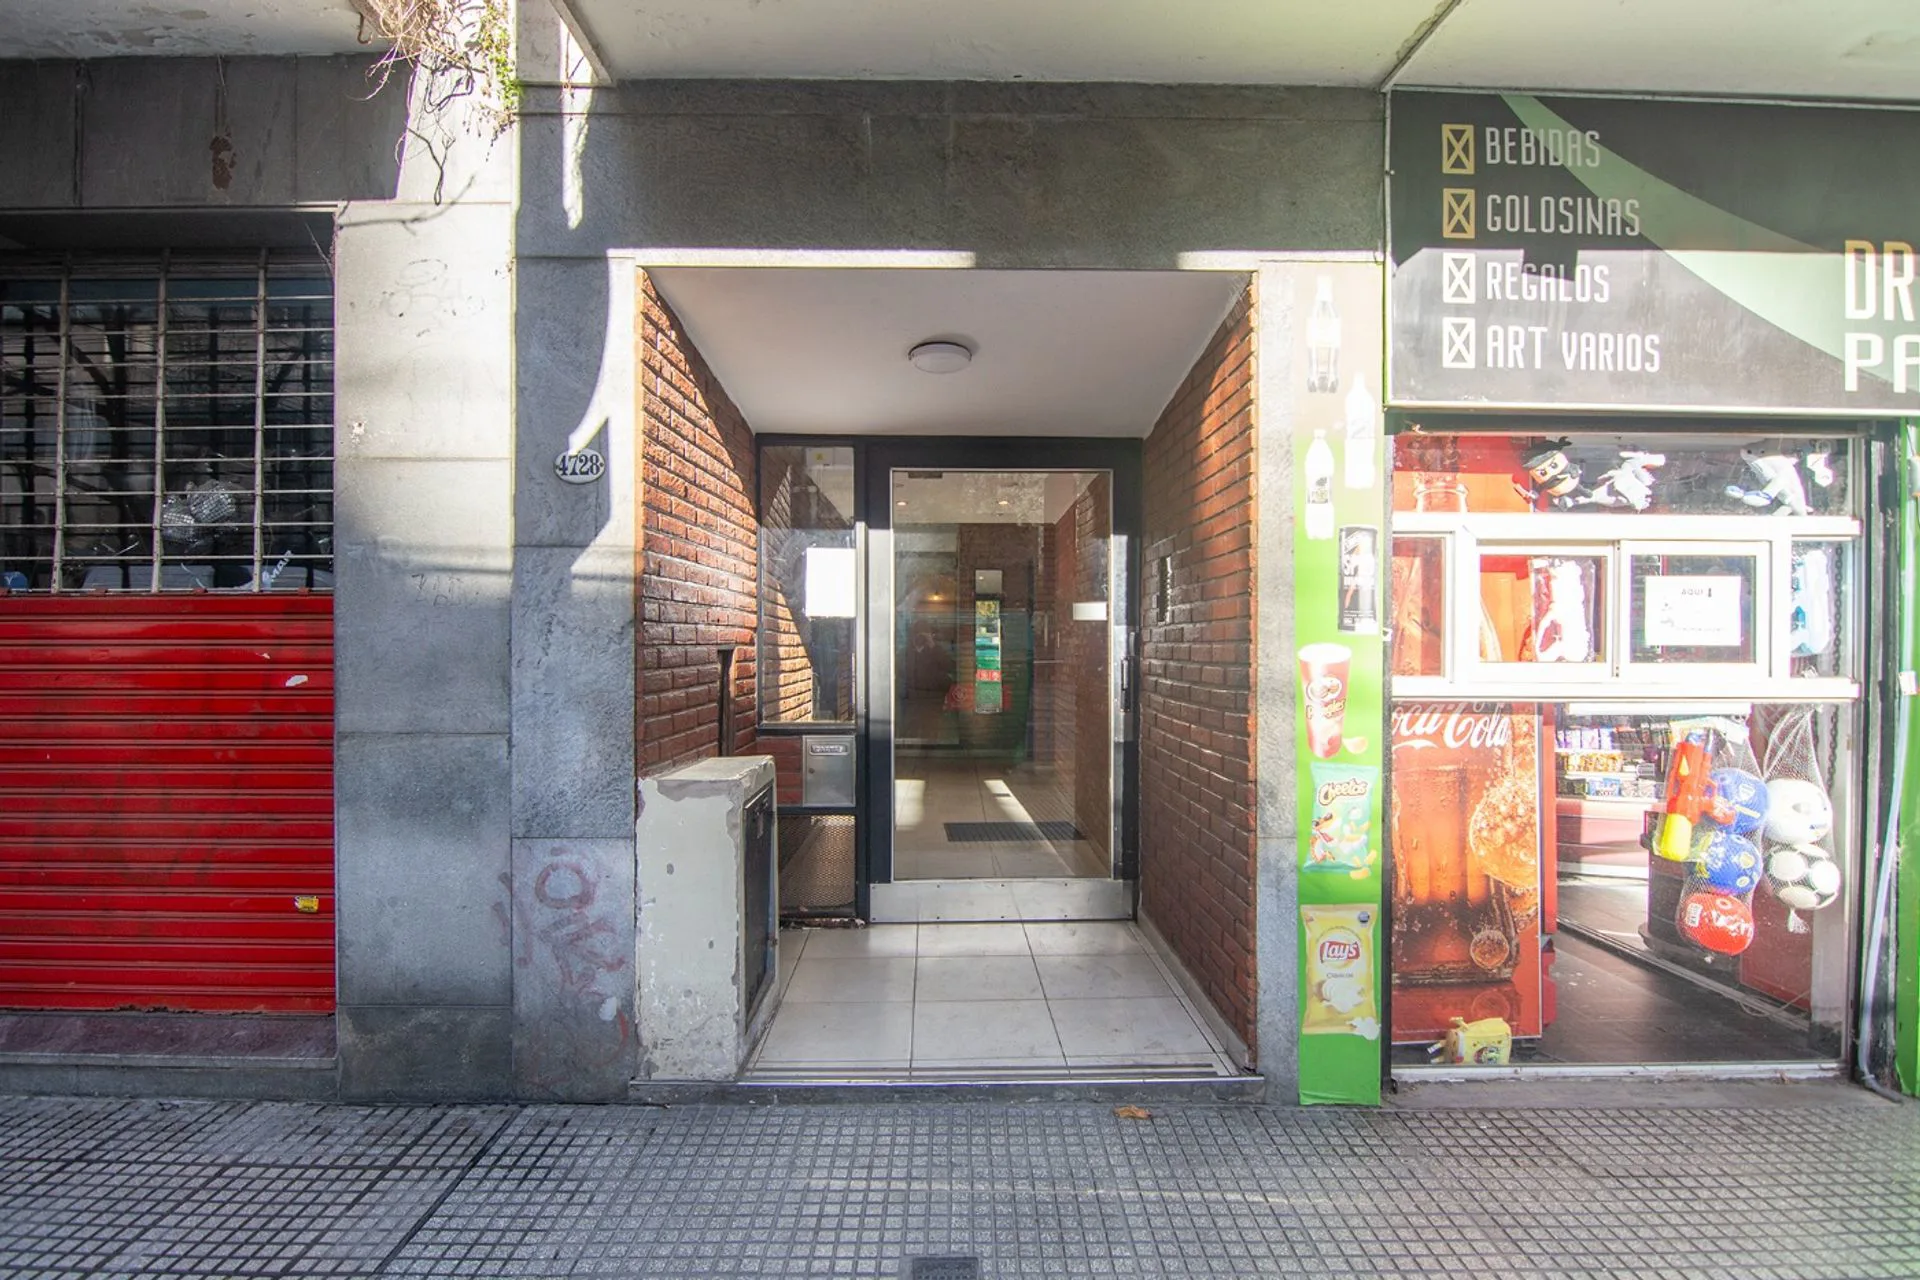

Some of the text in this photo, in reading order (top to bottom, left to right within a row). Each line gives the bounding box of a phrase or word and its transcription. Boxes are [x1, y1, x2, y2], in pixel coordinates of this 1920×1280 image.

[1485, 127, 1600, 167] BEBIDAS
[1486, 194, 1640, 236] GOLOSINAS
[1486, 261, 1610, 303] REGALOS
[1486, 325, 1660, 372] ART VARIOS
[558, 454, 601, 476] 4728
[1318, 778, 1368, 806] Cheetos
